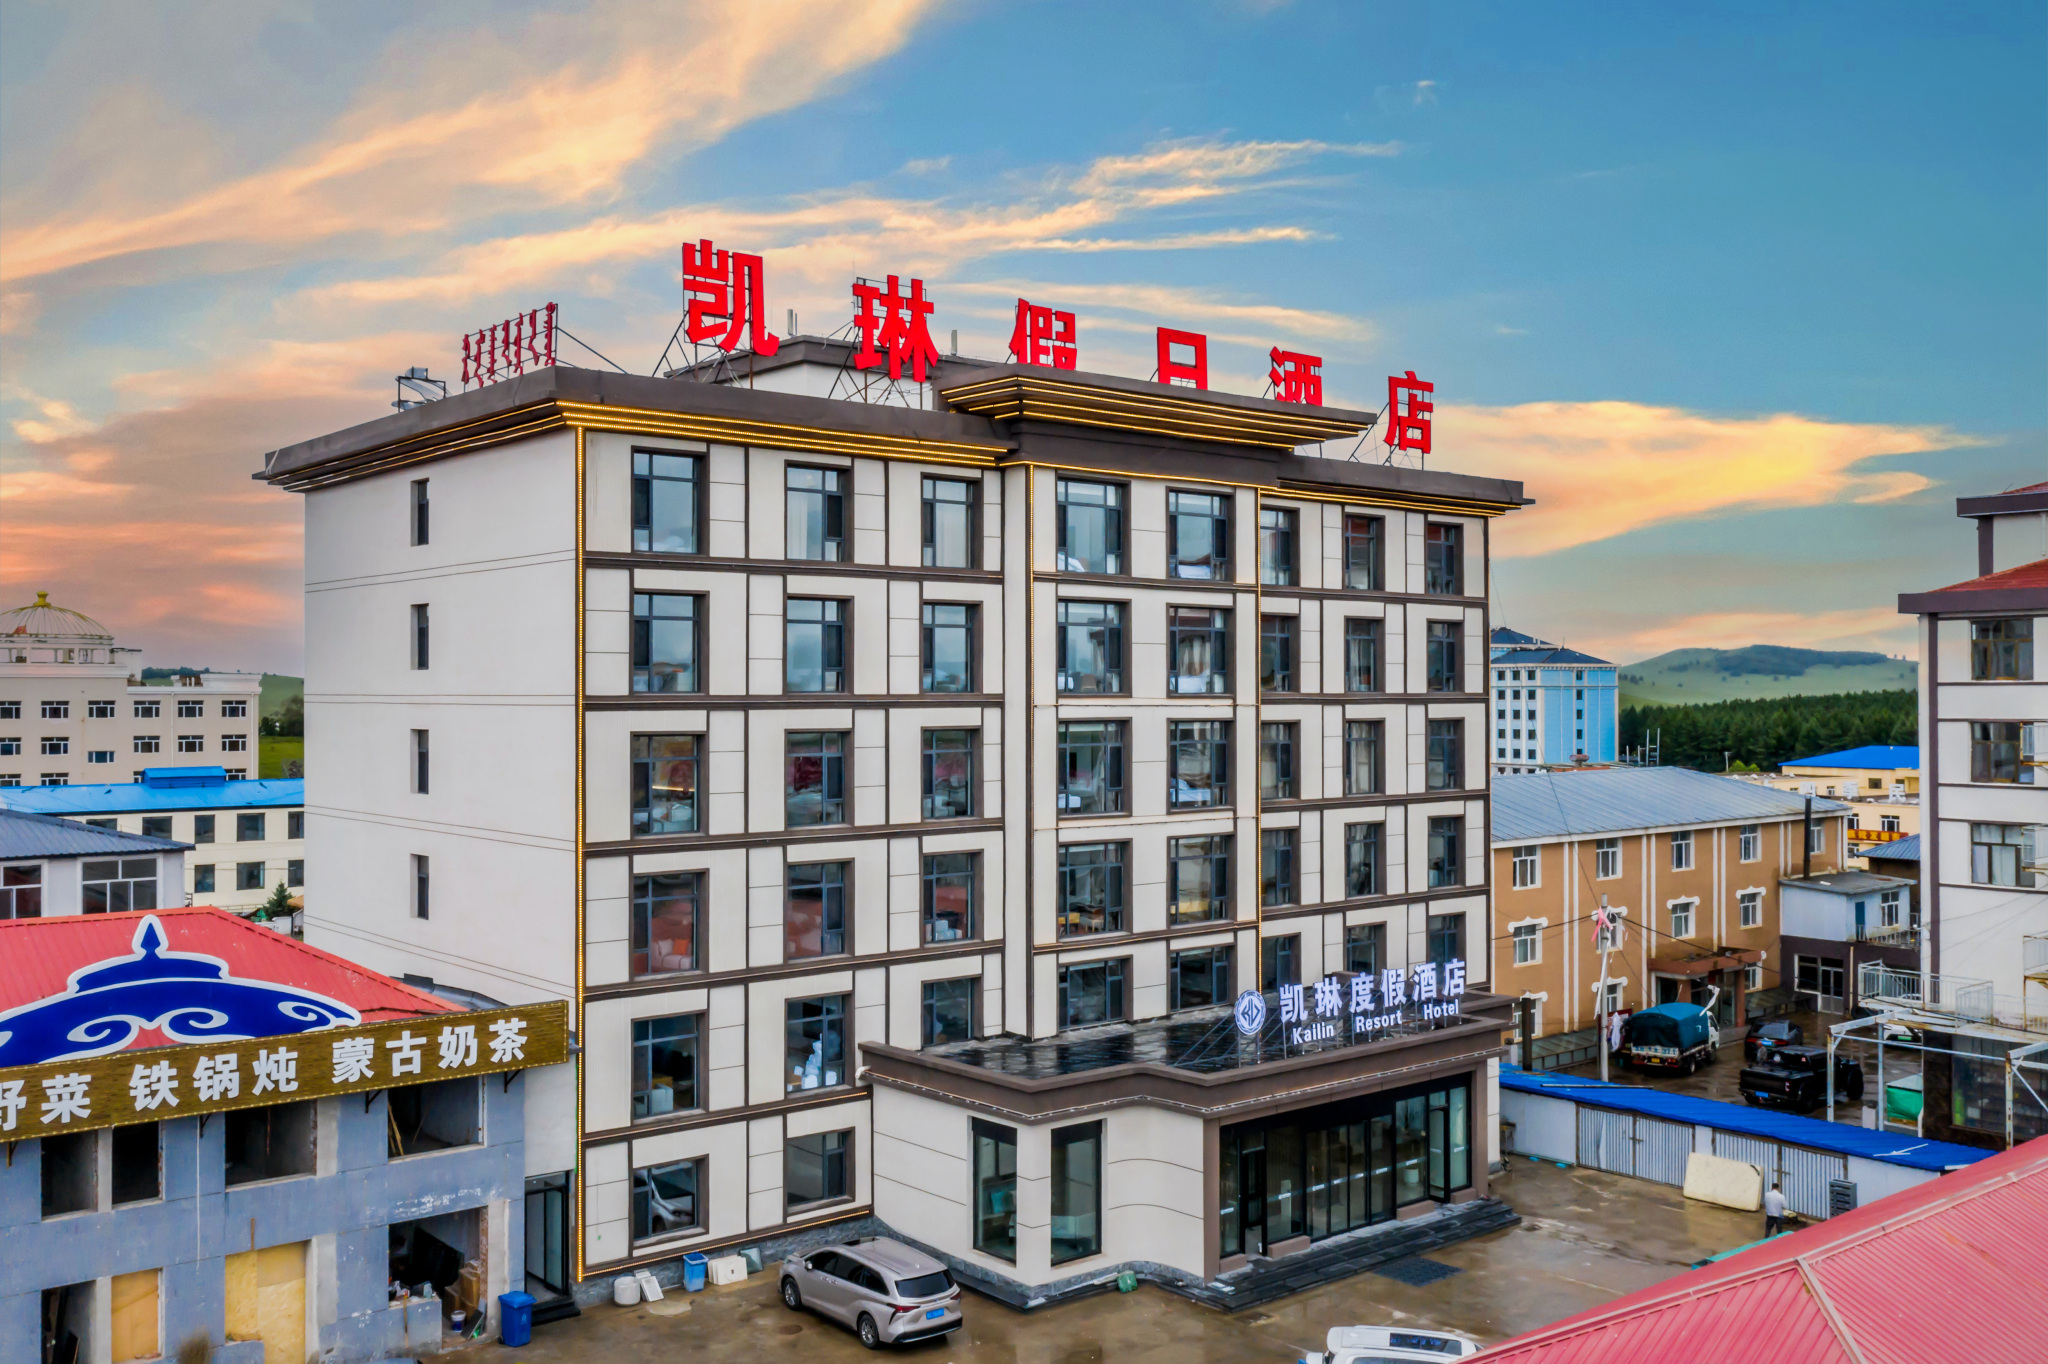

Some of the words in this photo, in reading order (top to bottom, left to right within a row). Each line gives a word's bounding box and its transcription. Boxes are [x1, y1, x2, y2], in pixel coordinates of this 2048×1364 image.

[1279, 958, 1465, 1023] 凯琳度假酒店
[1293, 1022, 1334, 1045] Kailin
[1356, 1009, 1402, 1033] Resort
[1423, 999, 1459, 1020] Hotel
[129, 1047, 298, 1111] 铁锅炖
[332, 1018, 528, 1085] 蒙古奶茶
